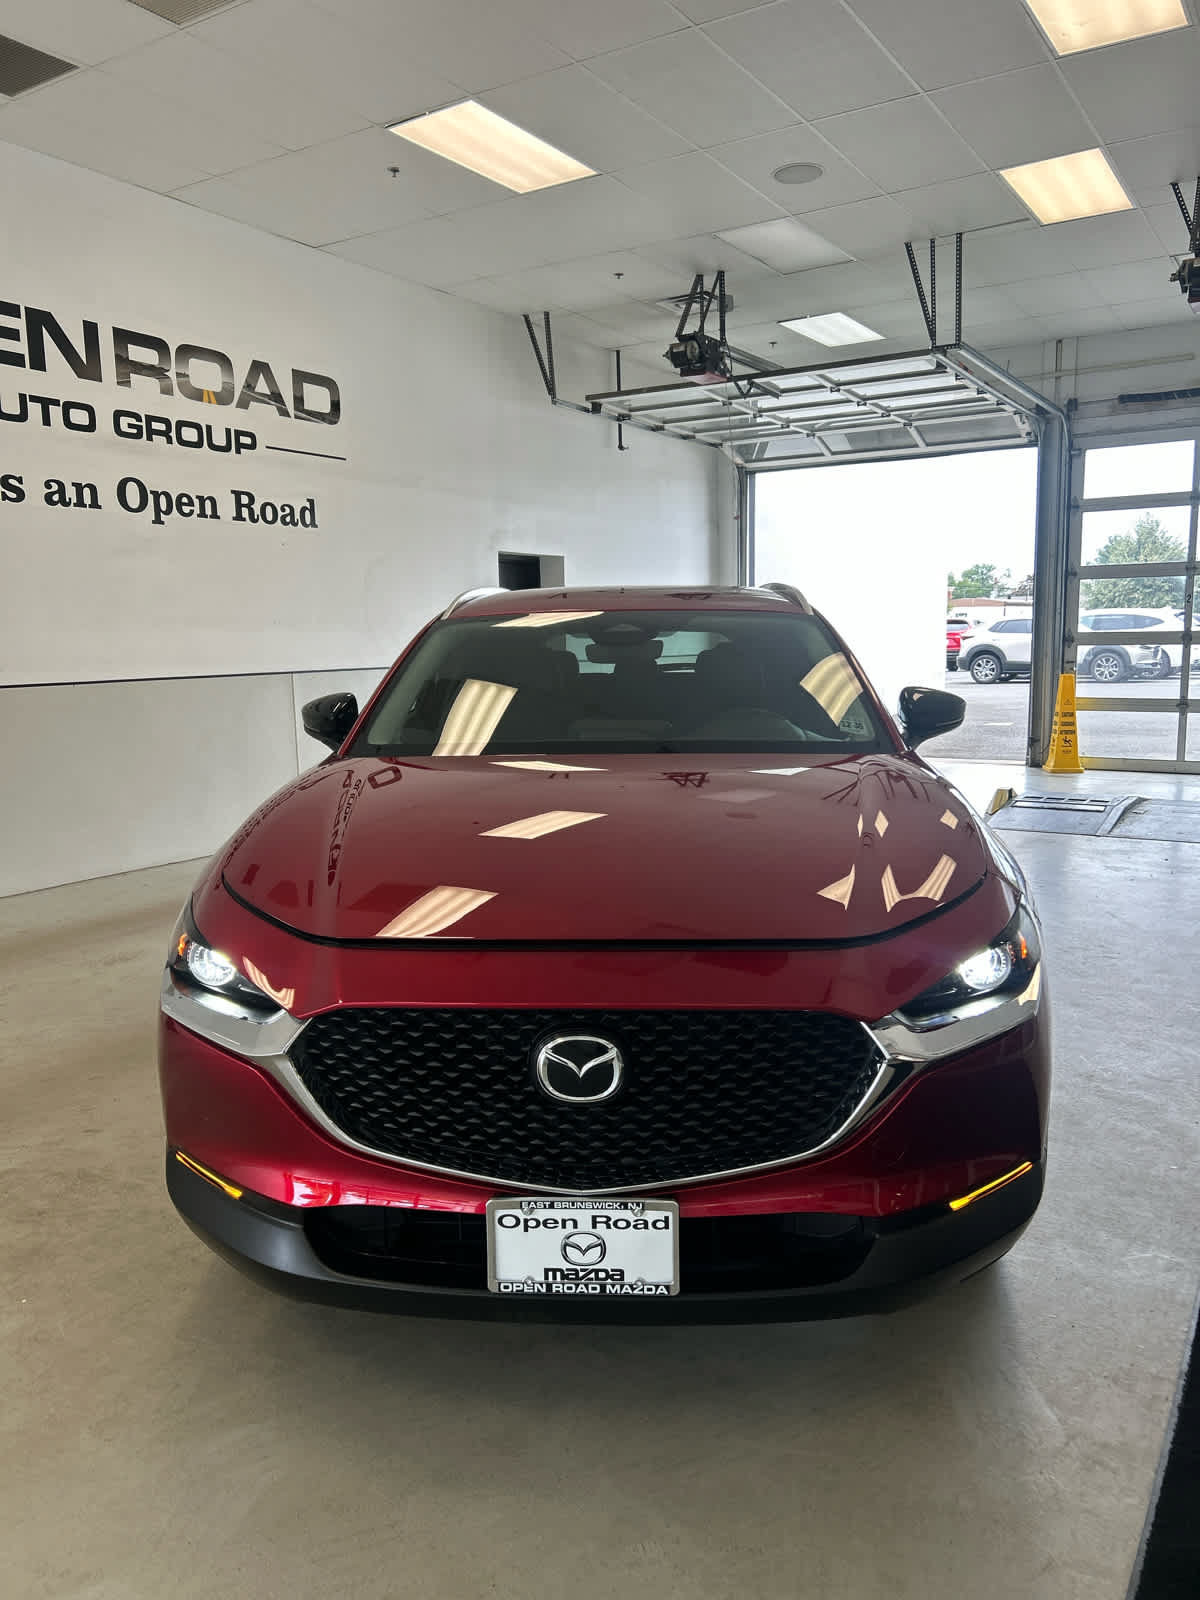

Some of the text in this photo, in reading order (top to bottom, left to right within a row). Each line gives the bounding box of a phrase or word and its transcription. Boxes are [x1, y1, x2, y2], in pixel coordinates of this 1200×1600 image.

[112, 326, 341, 426] ROAD
[113, 409, 257, 454] GROUP
[44, 478, 102, 510] an
[116, 477, 221, 525] Open
[230, 489, 318, 528] Road
[522, 1201, 549, 1209] EAST
[628, 1202, 643, 1210] NJ
[497, 1213, 670, 1232] Open Road
[544, 1267, 625, 1282] mazda
[500, 1282, 669, 1295] OPEN ROAD MAZDA
